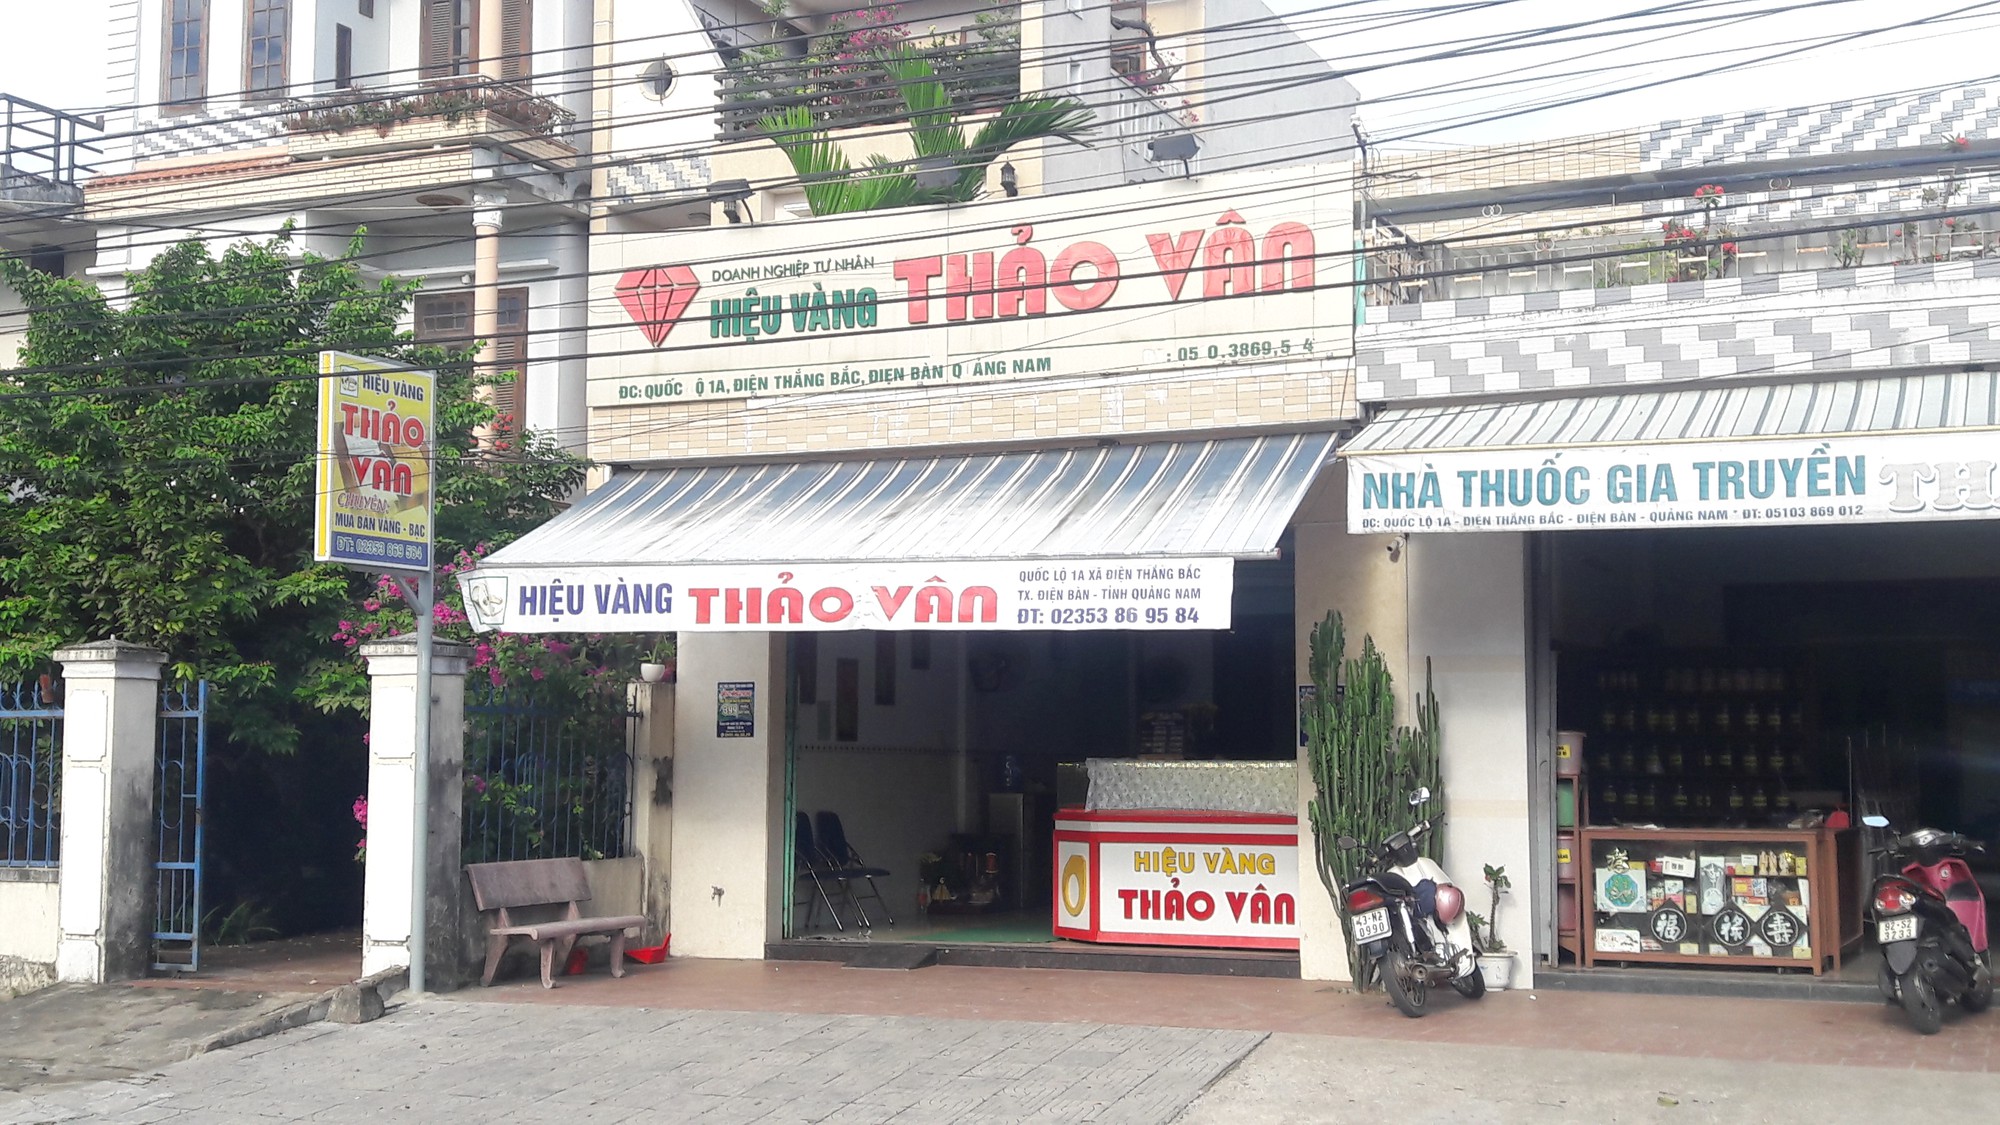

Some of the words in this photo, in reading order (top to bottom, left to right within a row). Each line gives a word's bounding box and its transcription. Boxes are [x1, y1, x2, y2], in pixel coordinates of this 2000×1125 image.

[712, 266, 760, 282] DOANH
[764, 259, 809, 278] NGHIỆP
[813, 258, 831, 273] TƯ
[835, 254, 875, 271] NHÂN
[893, 222, 1120, 324] THẢO
[1145, 208, 1316, 301] VÂN
[710, 287, 782, 343] HIỆU
[789, 282, 878, 332] VÀNG
[363, 374, 390, 395] HIỆU
[393, 380, 424, 401] VÀNG
[618, 385, 642, 399] ĐC:
[645, 378, 684, 398] QUỐC
[774, 368, 824, 390] THẮNG
[911, 362, 943, 381] BÀN
[1013, 357, 1051, 374] NAM
[341, 400, 425, 448] THẢO
[351, 451, 412, 495] VÂN
[1362, 462, 1443, 510] NHÀ
[1457, 452, 1590, 508] THUỐC
[1606, 463, 1678, 504] GIA
[1692, 442, 1867, 501] TRUYỀN
[1879, 460, 2000, 514] TH
[334, 512, 354, 528] MUA
[357, 514, 376, 531] BÁN
[378, 516, 401, 534] VÀNG
[409, 523, 426, 540] BẠC
[1362, 518, 1380, 529] ĐC:
[1383, 514, 1416, 528] QUỐC
[1419, 515, 1433, 529] LỘ
[1437, 517, 1451, 527] 1A
[1539, 510, 1564, 525] BẮC
[1577, 510, 1606, 526] ĐIỆN
[1610, 510, 1637, 523] BÀN
[1649, 507, 1693, 523] QUẢNG
[1698, 509, 1728, 521] NAM
[1742, 508, 1761, 519] ĐT:
[1765, 507, 1806, 518] 05103
[1810, 506, 1834, 517] 869
[1838, 504, 1864, 516] 012
[336, 535, 355, 552] ĐT:
[355, 538, 386, 556] 02353
[386, 542, 404, 559] 869
[1019, 566, 1050, 583] QUỐC
[1054, 566, 1067, 584] LỘ
[1071, 569, 1085, 581] 1A
[1088, 566, 1102, 581] XÃ
[1106, 565, 1133, 583] ĐIỆN
[1137, 563, 1174, 580] THẮNG
[1178, 563, 1201, 580] BẮC
[518, 578, 584, 622] HIỆU
[594, 577, 673, 615] VÀNG
[688, 571, 854, 625] THẢO
[870, 575, 998, 624] VÂN
[1017, 589, 1034, 601] TX.
[1037, 586, 1064, 604] ĐIỆN
[1067, 586, 1090, 601] BÀN
[1131, 584, 1171, 601] QUẢNG
[1175, 587, 1201, 600] NAM
[1017, 607, 1044, 624] ĐT:
[1051, 607, 1108, 624] 02353
[1114, 606, 1138, 624] 86
[1145, 606, 1168, 624] 95
[1175, 606, 1199, 624] 84
[1134, 846, 1195, 877] HIỆU
[1203, 847, 1276, 876] VÀNG
[1118, 877, 1215, 921] THẢO
[1225, 883, 1296, 925] VÂN
[1359, 922, 1385, 938] 0990
[1884, 929, 1912, 941] 3233
